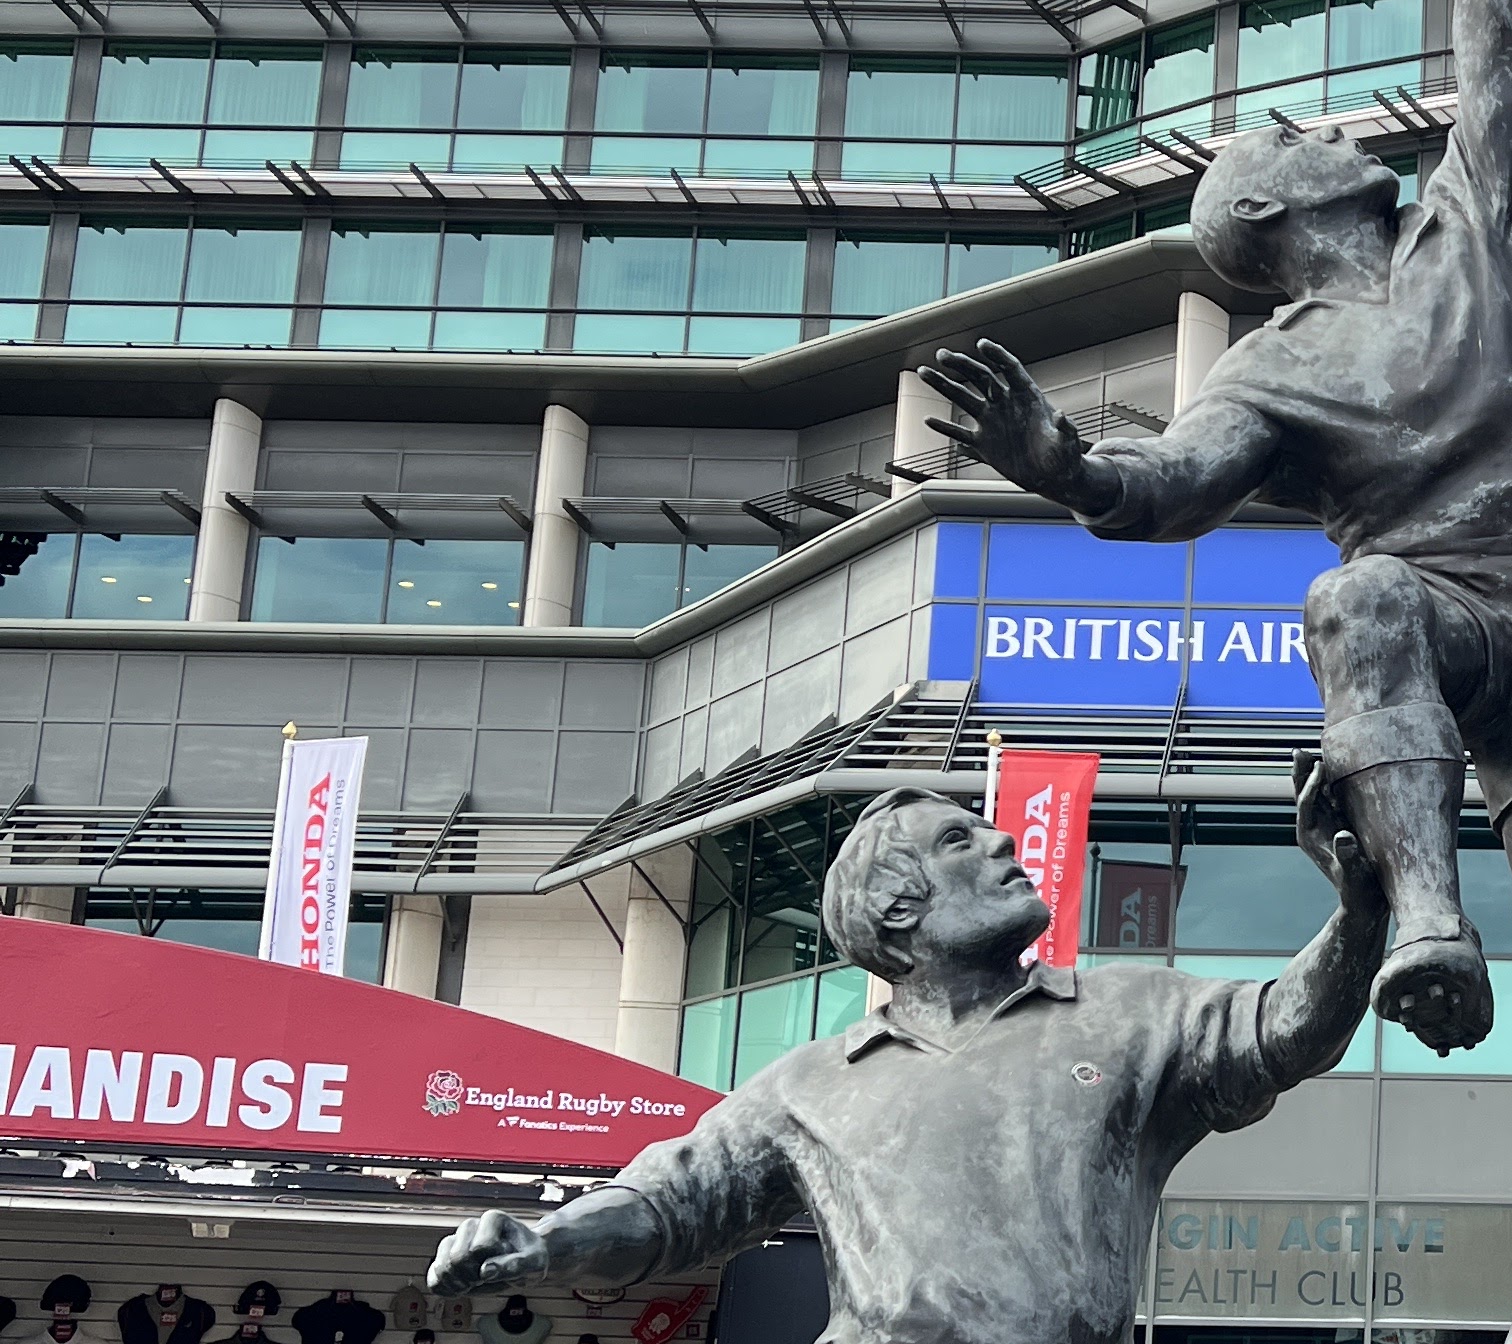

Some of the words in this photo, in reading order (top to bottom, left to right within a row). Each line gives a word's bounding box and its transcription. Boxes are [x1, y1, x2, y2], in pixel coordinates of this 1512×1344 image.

[985, 616, 1205, 662] BRITISH
[1217, 620, 1309, 664] AIR
[329, 779, 345, 846] Dreams
[1052, 791, 1071, 859] Dreams
[301, 772, 331, 972] HONDA
[326, 854, 336, 870] of
[1052, 863, 1065, 881] of
[325, 877, 336, 931] Power
[325, 936, 335, 968] The
[0, 1043, 348, 1133] ANDISE
[465, 1087, 552, 1110] England
[557, 1093, 625, 1117] Rugby
[630, 1096, 686, 1116] Store
[497, 1119, 506, 1128] A
[519, 1119, 557, 1131] Fanatics
[559, 1121, 609, 1133] Experience
[1297, 1270, 1405, 1307] CLUB
